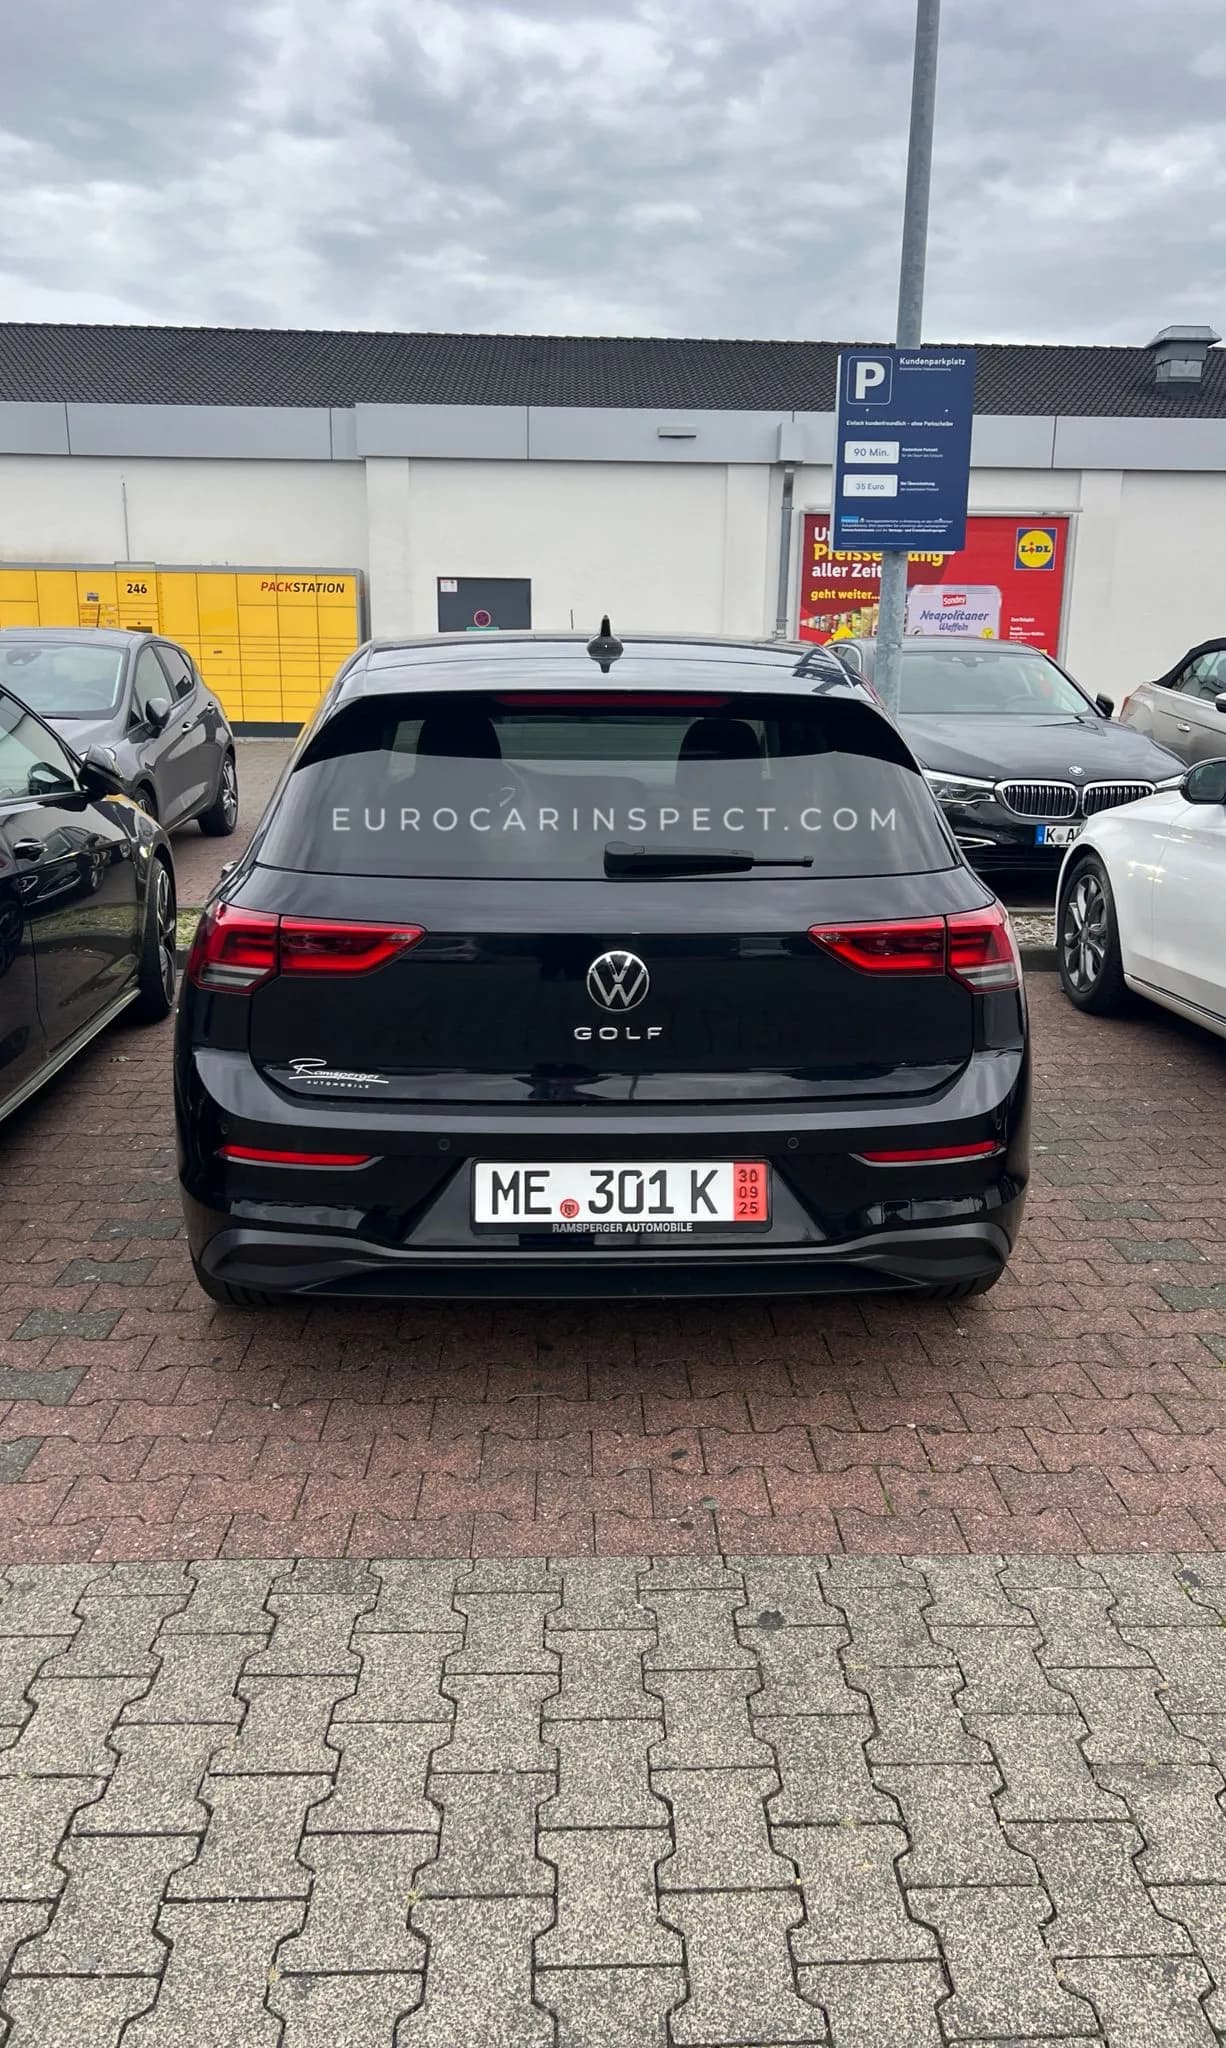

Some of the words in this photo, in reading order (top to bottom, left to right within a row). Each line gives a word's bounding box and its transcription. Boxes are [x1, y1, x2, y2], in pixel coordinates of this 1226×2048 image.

[900, 357, 966, 367] Kundenparkplatz
[856, 362, 886, 400] P
[854, 448, 867, 457] 90
[869, 447, 890, 457] Min.
[812, 563, 849, 578] aller
[126, 583, 148, 594] 246
[260, 581, 345, 593] PACKSTATION
[811, 589, 836, 601] geht
[919, 610, 989, 622] Neapolitaner
[939, 622, 968, 632] Waffeln
[1046, 828, 1056, 843] K
[574, 1026, 663, 1040] GOLF
[288, 1058, 380, 1081] Ramsperger
[738, 1169, 759, 1183] 30
[491, 1170, 552, 1215] ME
[588, 1170, 675, 1215] 301
[690, 1170, 719, 1215] K
[738, 1185, 759, 1199] 09
[738, 1202, 759, 1216] 25
[552, 1222, 623, 1234] RAMSPERGER
[625, 1222, 694, 1233] AUTOMOBILE
